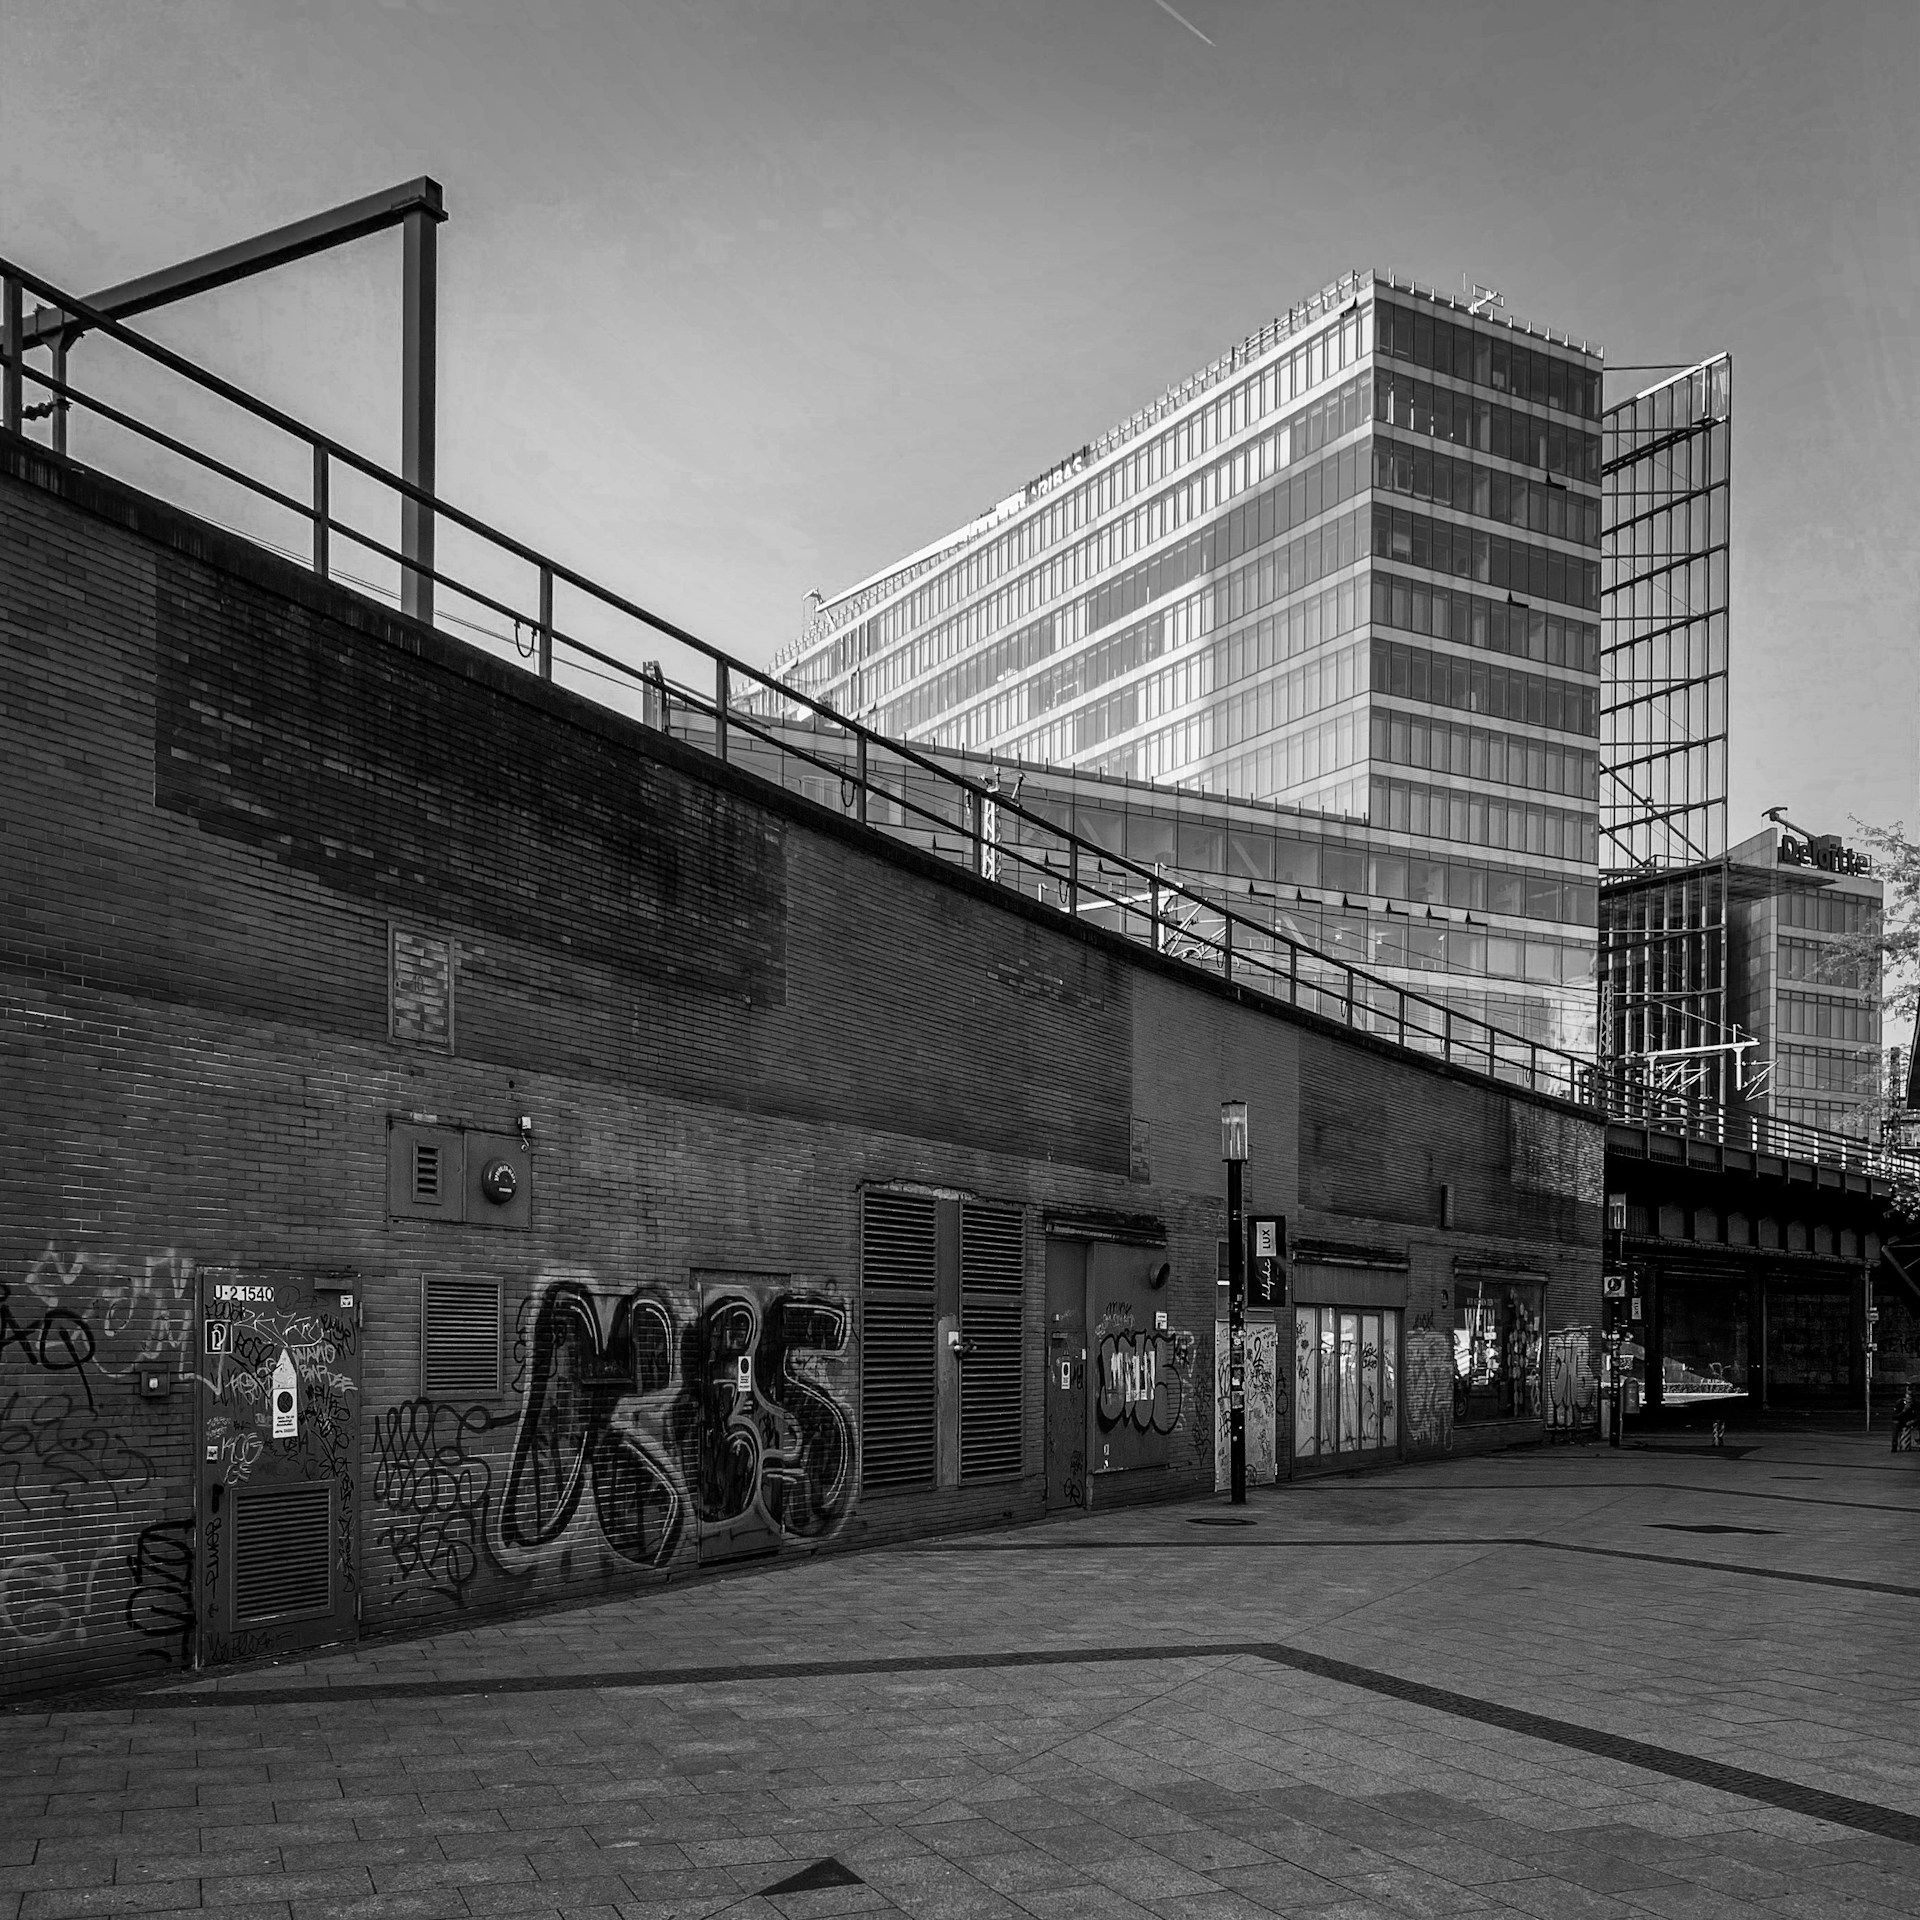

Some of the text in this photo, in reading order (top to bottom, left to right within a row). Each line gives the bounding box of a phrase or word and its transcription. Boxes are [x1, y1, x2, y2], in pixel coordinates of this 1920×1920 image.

[1021, 456, 1083, 506] ARIBAS
[1782, 835, 1868, 875] Deloitte
[1262, 1229, 1271, 1249] LUX
